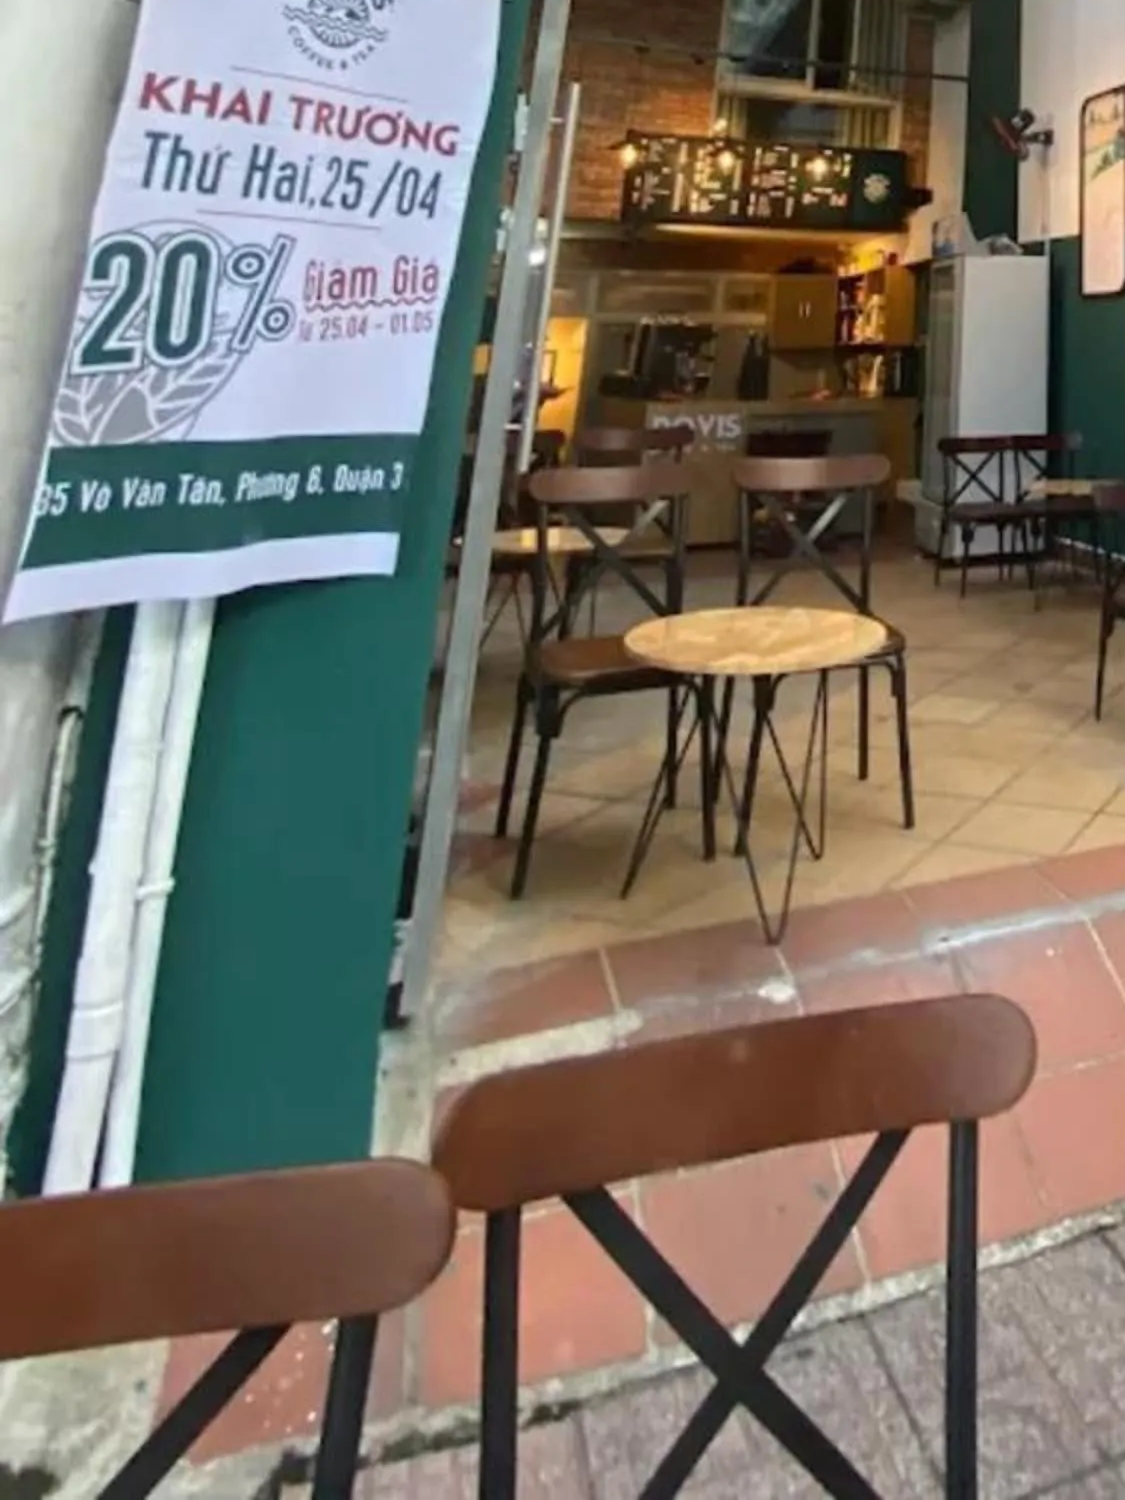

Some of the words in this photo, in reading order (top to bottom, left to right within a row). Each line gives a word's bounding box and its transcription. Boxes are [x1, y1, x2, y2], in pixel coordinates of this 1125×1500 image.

[138, 72, 273, 125] KHAI
[290, 95, 461, 157] TRƯƠNG
[141, 130, 232, 196] Thứ
[70, 229, 297, 375] 20%
